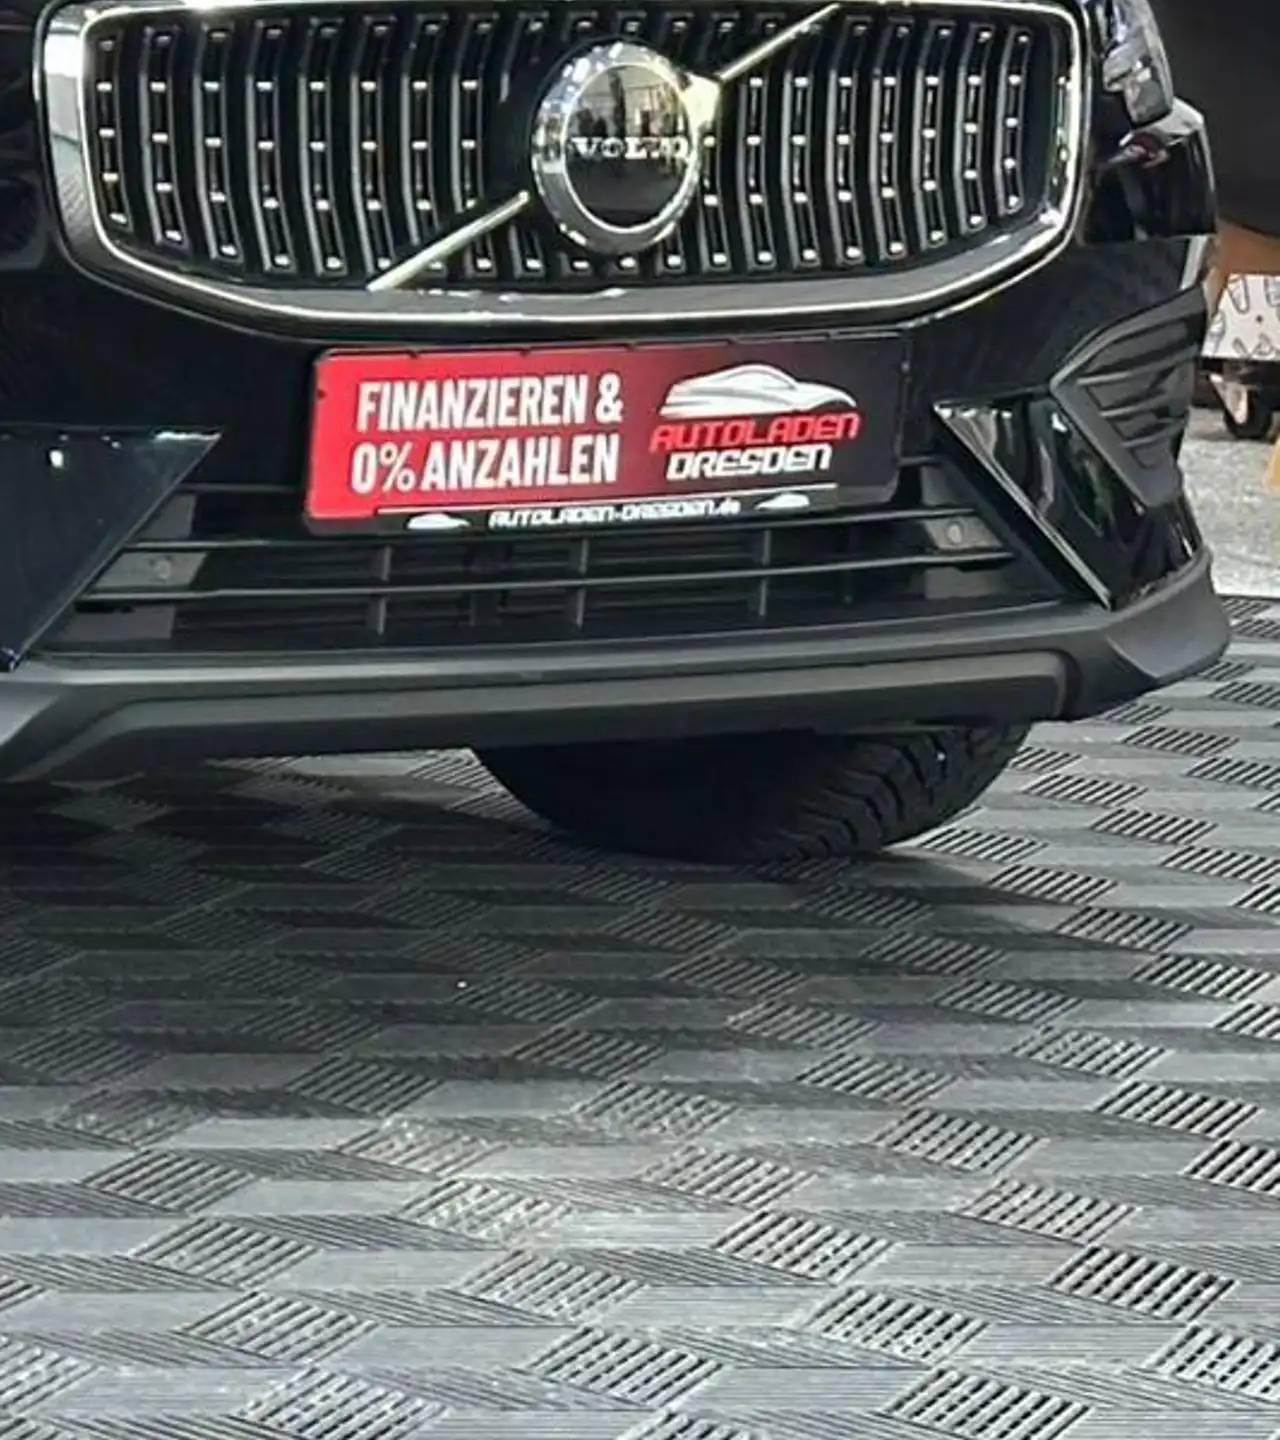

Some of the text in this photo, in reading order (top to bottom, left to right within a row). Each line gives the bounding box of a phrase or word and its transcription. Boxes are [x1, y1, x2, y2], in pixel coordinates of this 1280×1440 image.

[570, 136, 690, 160] VOLVO
[356, 371, 624, 433] FINANZIEREN &
[648, 412, 861, 454] AUTOLADEN
[350, 432, 620, 495] 0% ANZAHLEN
[665, 442, 833, 482] DRESDEN
